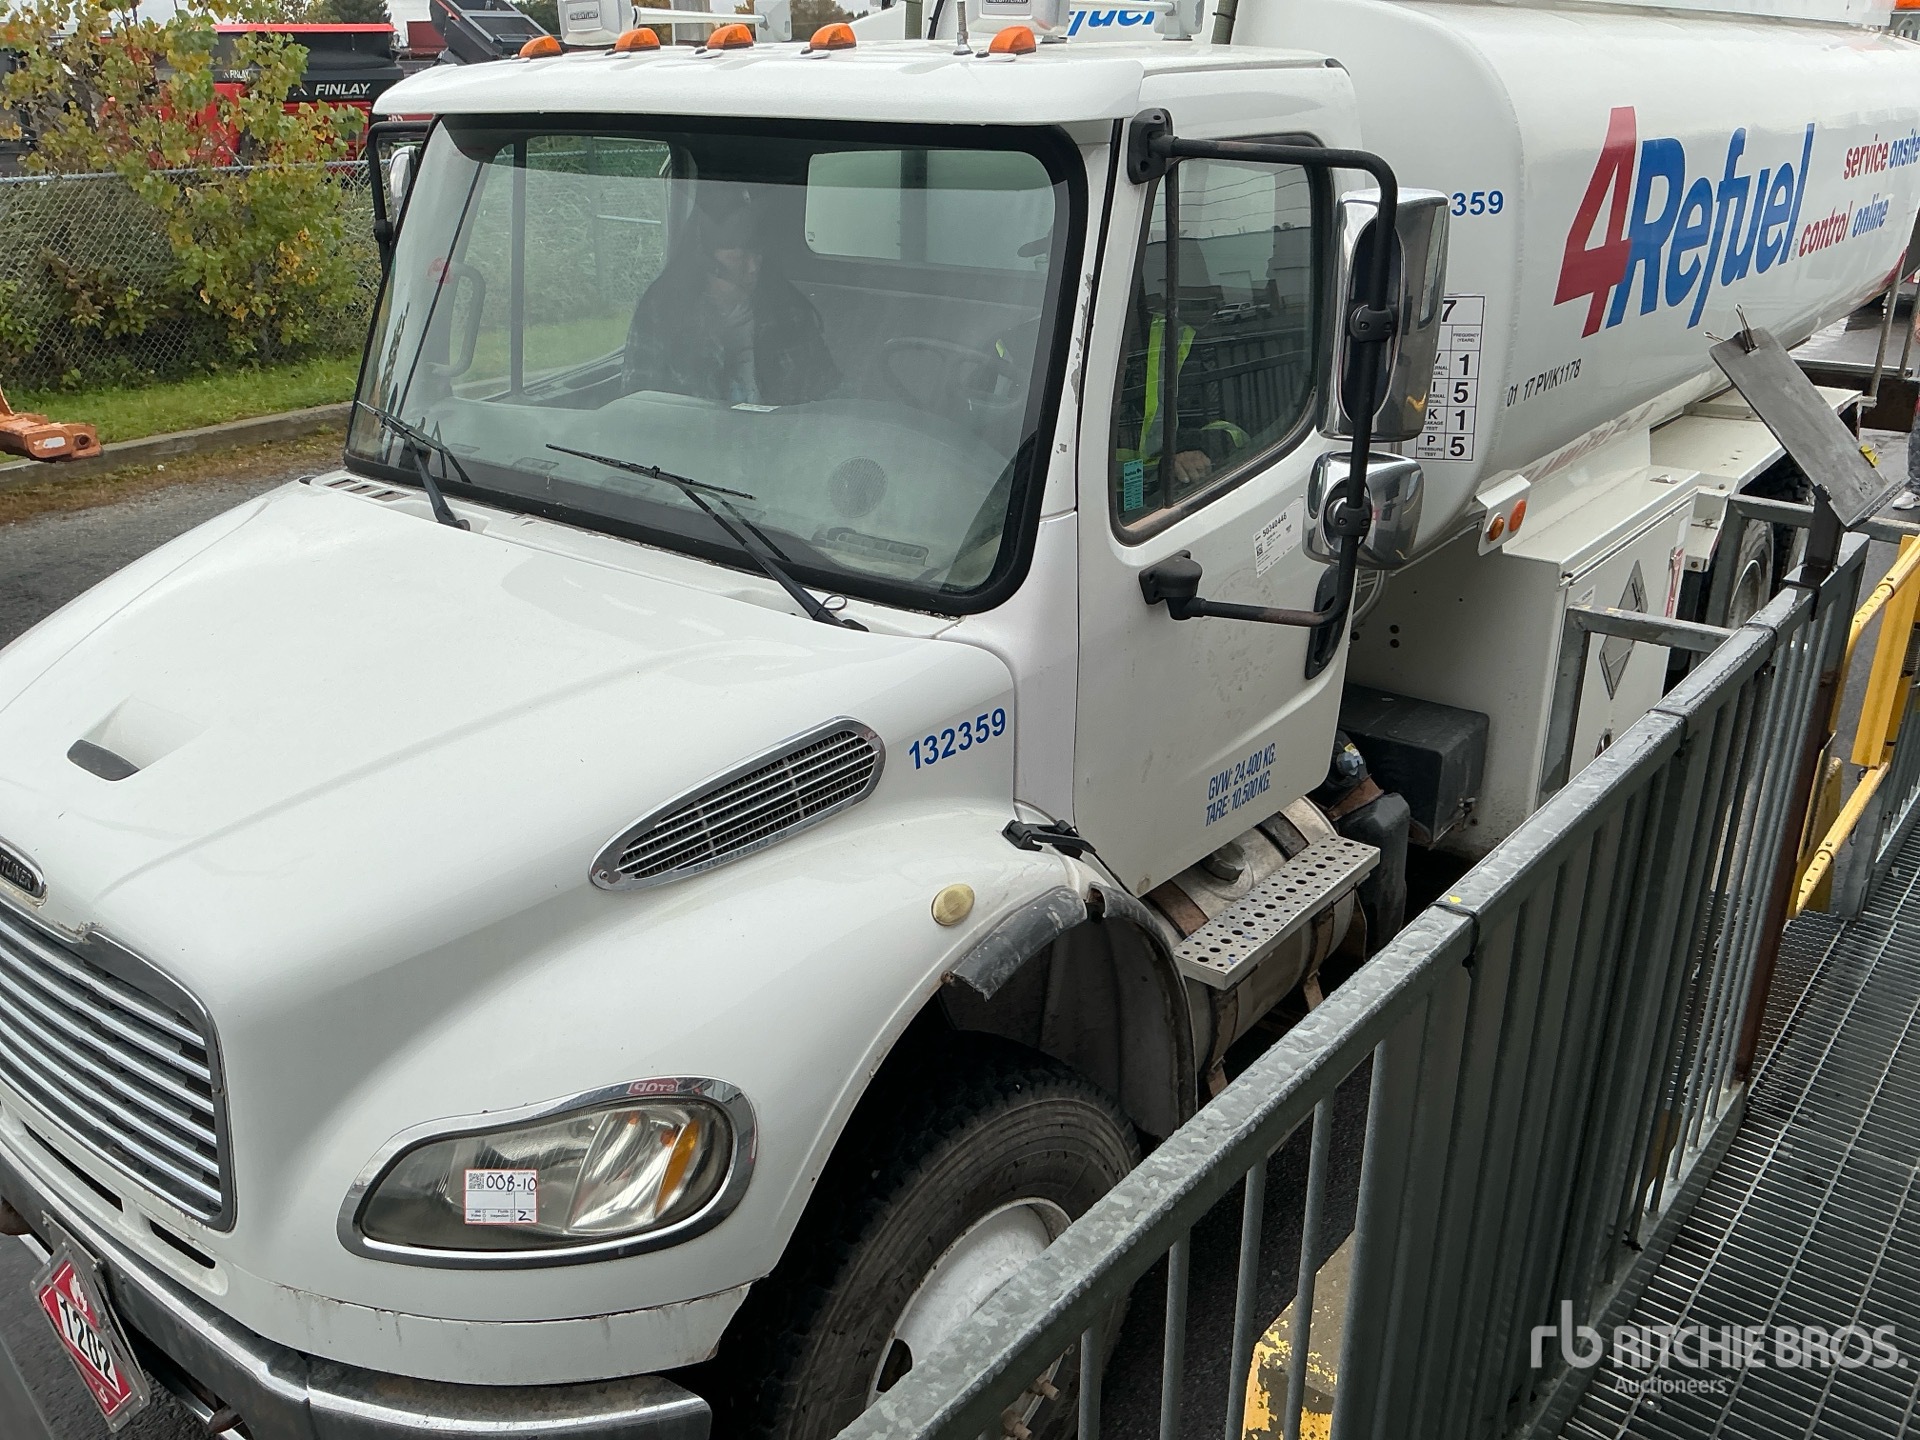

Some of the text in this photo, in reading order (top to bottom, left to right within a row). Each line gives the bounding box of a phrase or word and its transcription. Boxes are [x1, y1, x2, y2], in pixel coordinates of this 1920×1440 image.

[315, 83, 371, 96] FINLAY
[1843, 133, 1889, 180] service
[1451, 190, 1504, 216] 359
[1553, 106, 1815, 339] 4Refuel
[1798, 193, 1889, 258] control online
[1459, 353, 1469, 376] 1
[1453, 381, 1469, 404] 5
[1506, 384, 1519, 408] 01
[1523, 376, 1536, 402] 17
[1428, 408, 1438, 420] K
[1455, 409, 1466, 431] 1
[1427, 435, 1436, 446] P
[1450, 436, 1465, 457] 5
[908, 707, 1006, 770] 132359
[1208, 742, 1277, 801] GVW: 24,400 KG.
[1205, 795, 1231, 828] TARE:
[486, 1175, 538, 1192] 008-10
[59, 1299, 117, 1388] 1202
